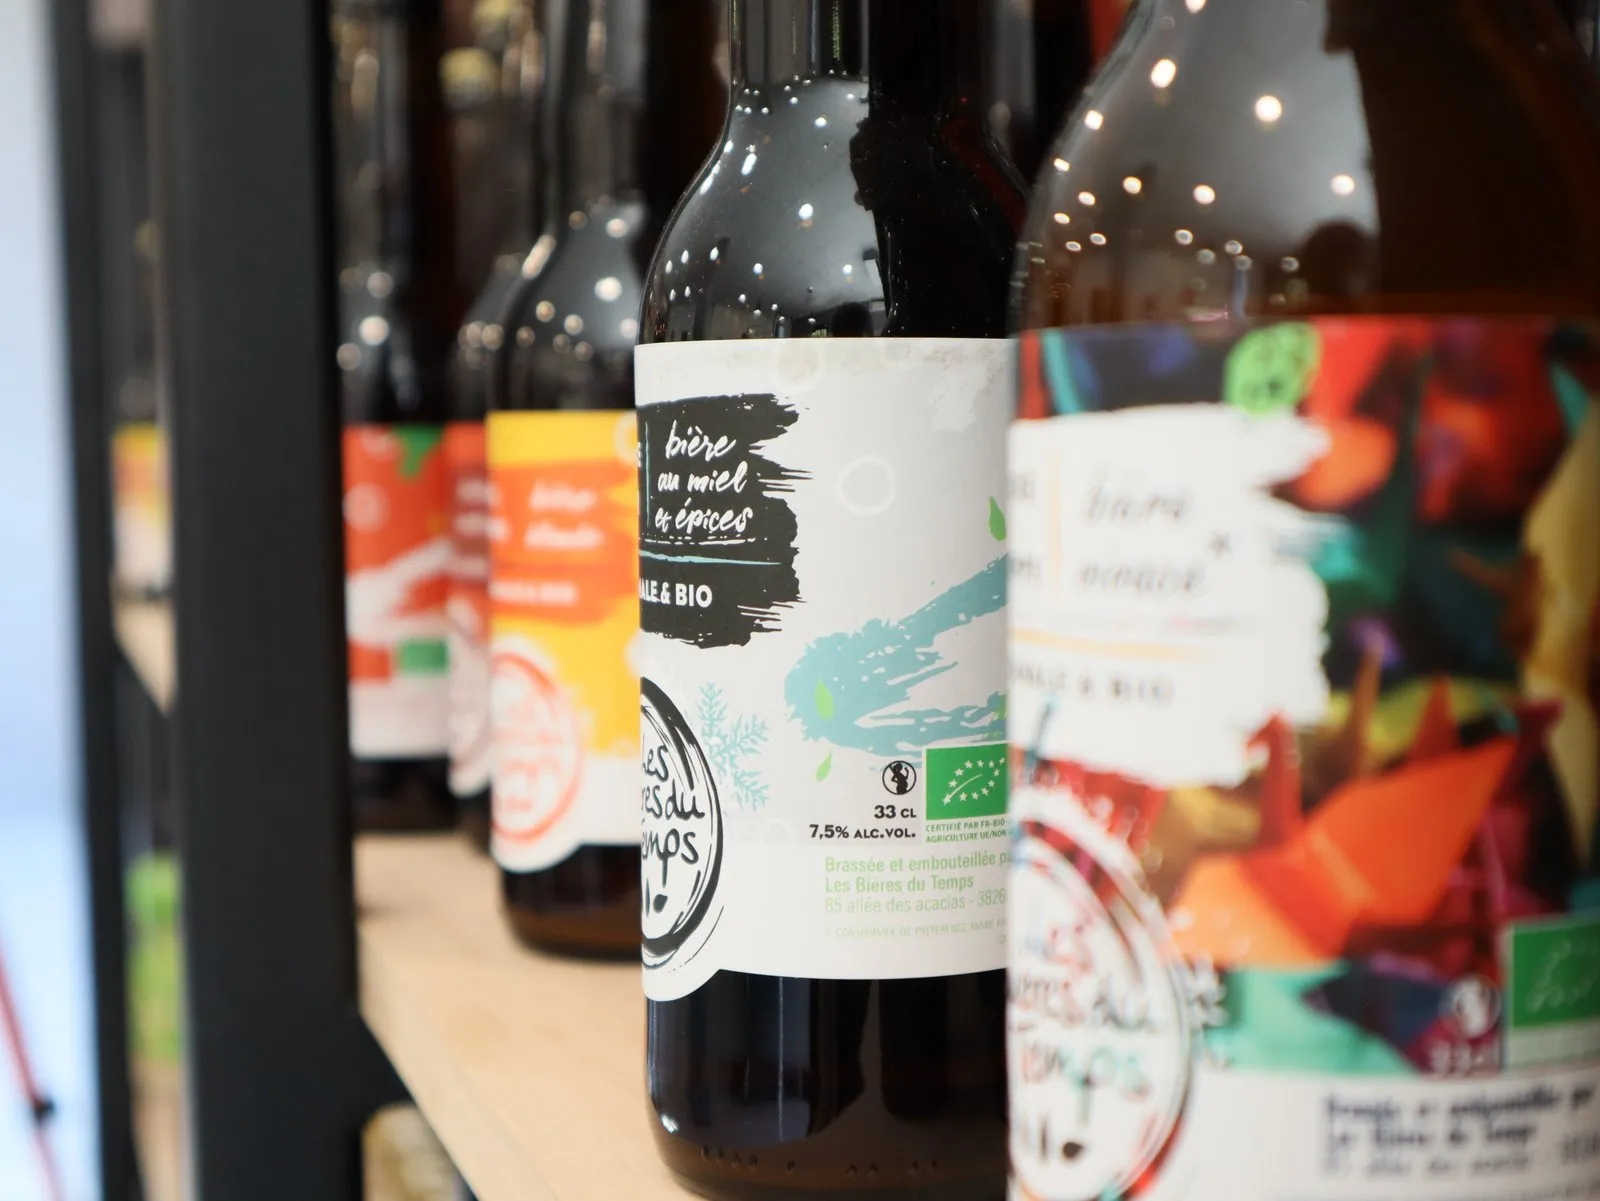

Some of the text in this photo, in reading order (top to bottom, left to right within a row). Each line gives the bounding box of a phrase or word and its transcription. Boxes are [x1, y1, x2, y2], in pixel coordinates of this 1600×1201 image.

[665, 420, 736, 461] bière
[657, 460, 748, 493] au miel
[655, 497, 753, 534] et épices
[660, 581, 671, 605] &
[676, 583, 713, 608] BIO
[665, 778, 705, 821] du
[874, 805, 917, 819] 33 CL
[809, 824, 850, 840] 7,5%
[925, 829, 1007, 843] AGRICULTURE UE/NON
[963, 821, 979, 830] PAR
[641, 828, 699, 888] emps
[825, 856, 885, 872] Brassée
[889, 857, 904, 872] et
[908, 850, 997, 872] embouteillée
[825, 874, 974, 893] Les Bières du Temps
[825, 897, 842, 913] 85
[847, 896, 882, 913] allée
[886, 896, 911, 912] des
[915, 896, 966, 912] acacias
[977, 887, 1008, 907] 3826
